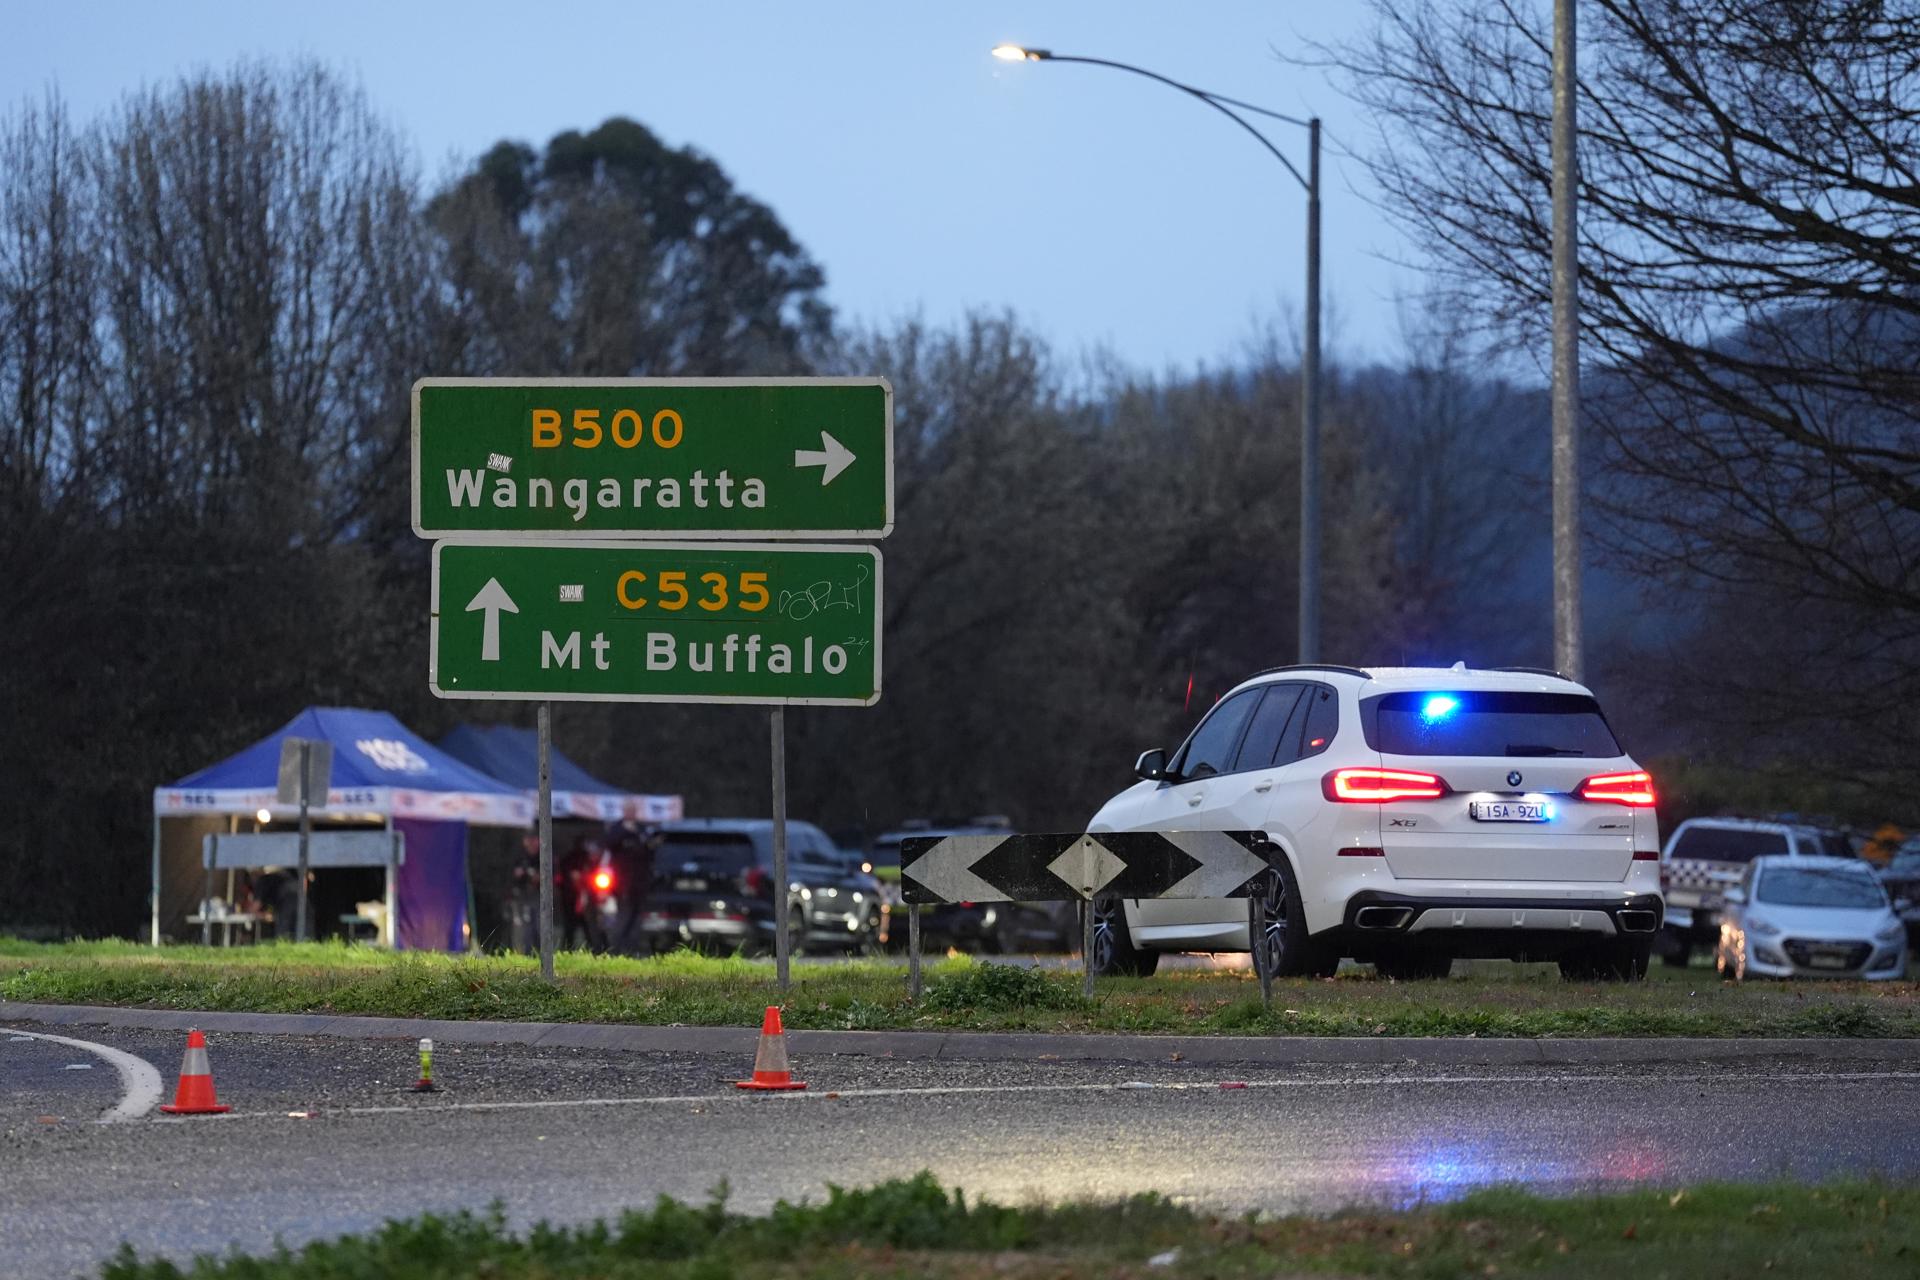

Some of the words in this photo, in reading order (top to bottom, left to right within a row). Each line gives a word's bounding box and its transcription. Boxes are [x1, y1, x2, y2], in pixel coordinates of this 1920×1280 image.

[532, 409, 683, 448] B500
[446, 468, 766, 522] Wangaratta
[560, 585, 584, 599] SWANK
[616, 570, 769, 611] C535
[541, 630, 610, 670] Mt
[646, 633, 847, 675] Buffalo
